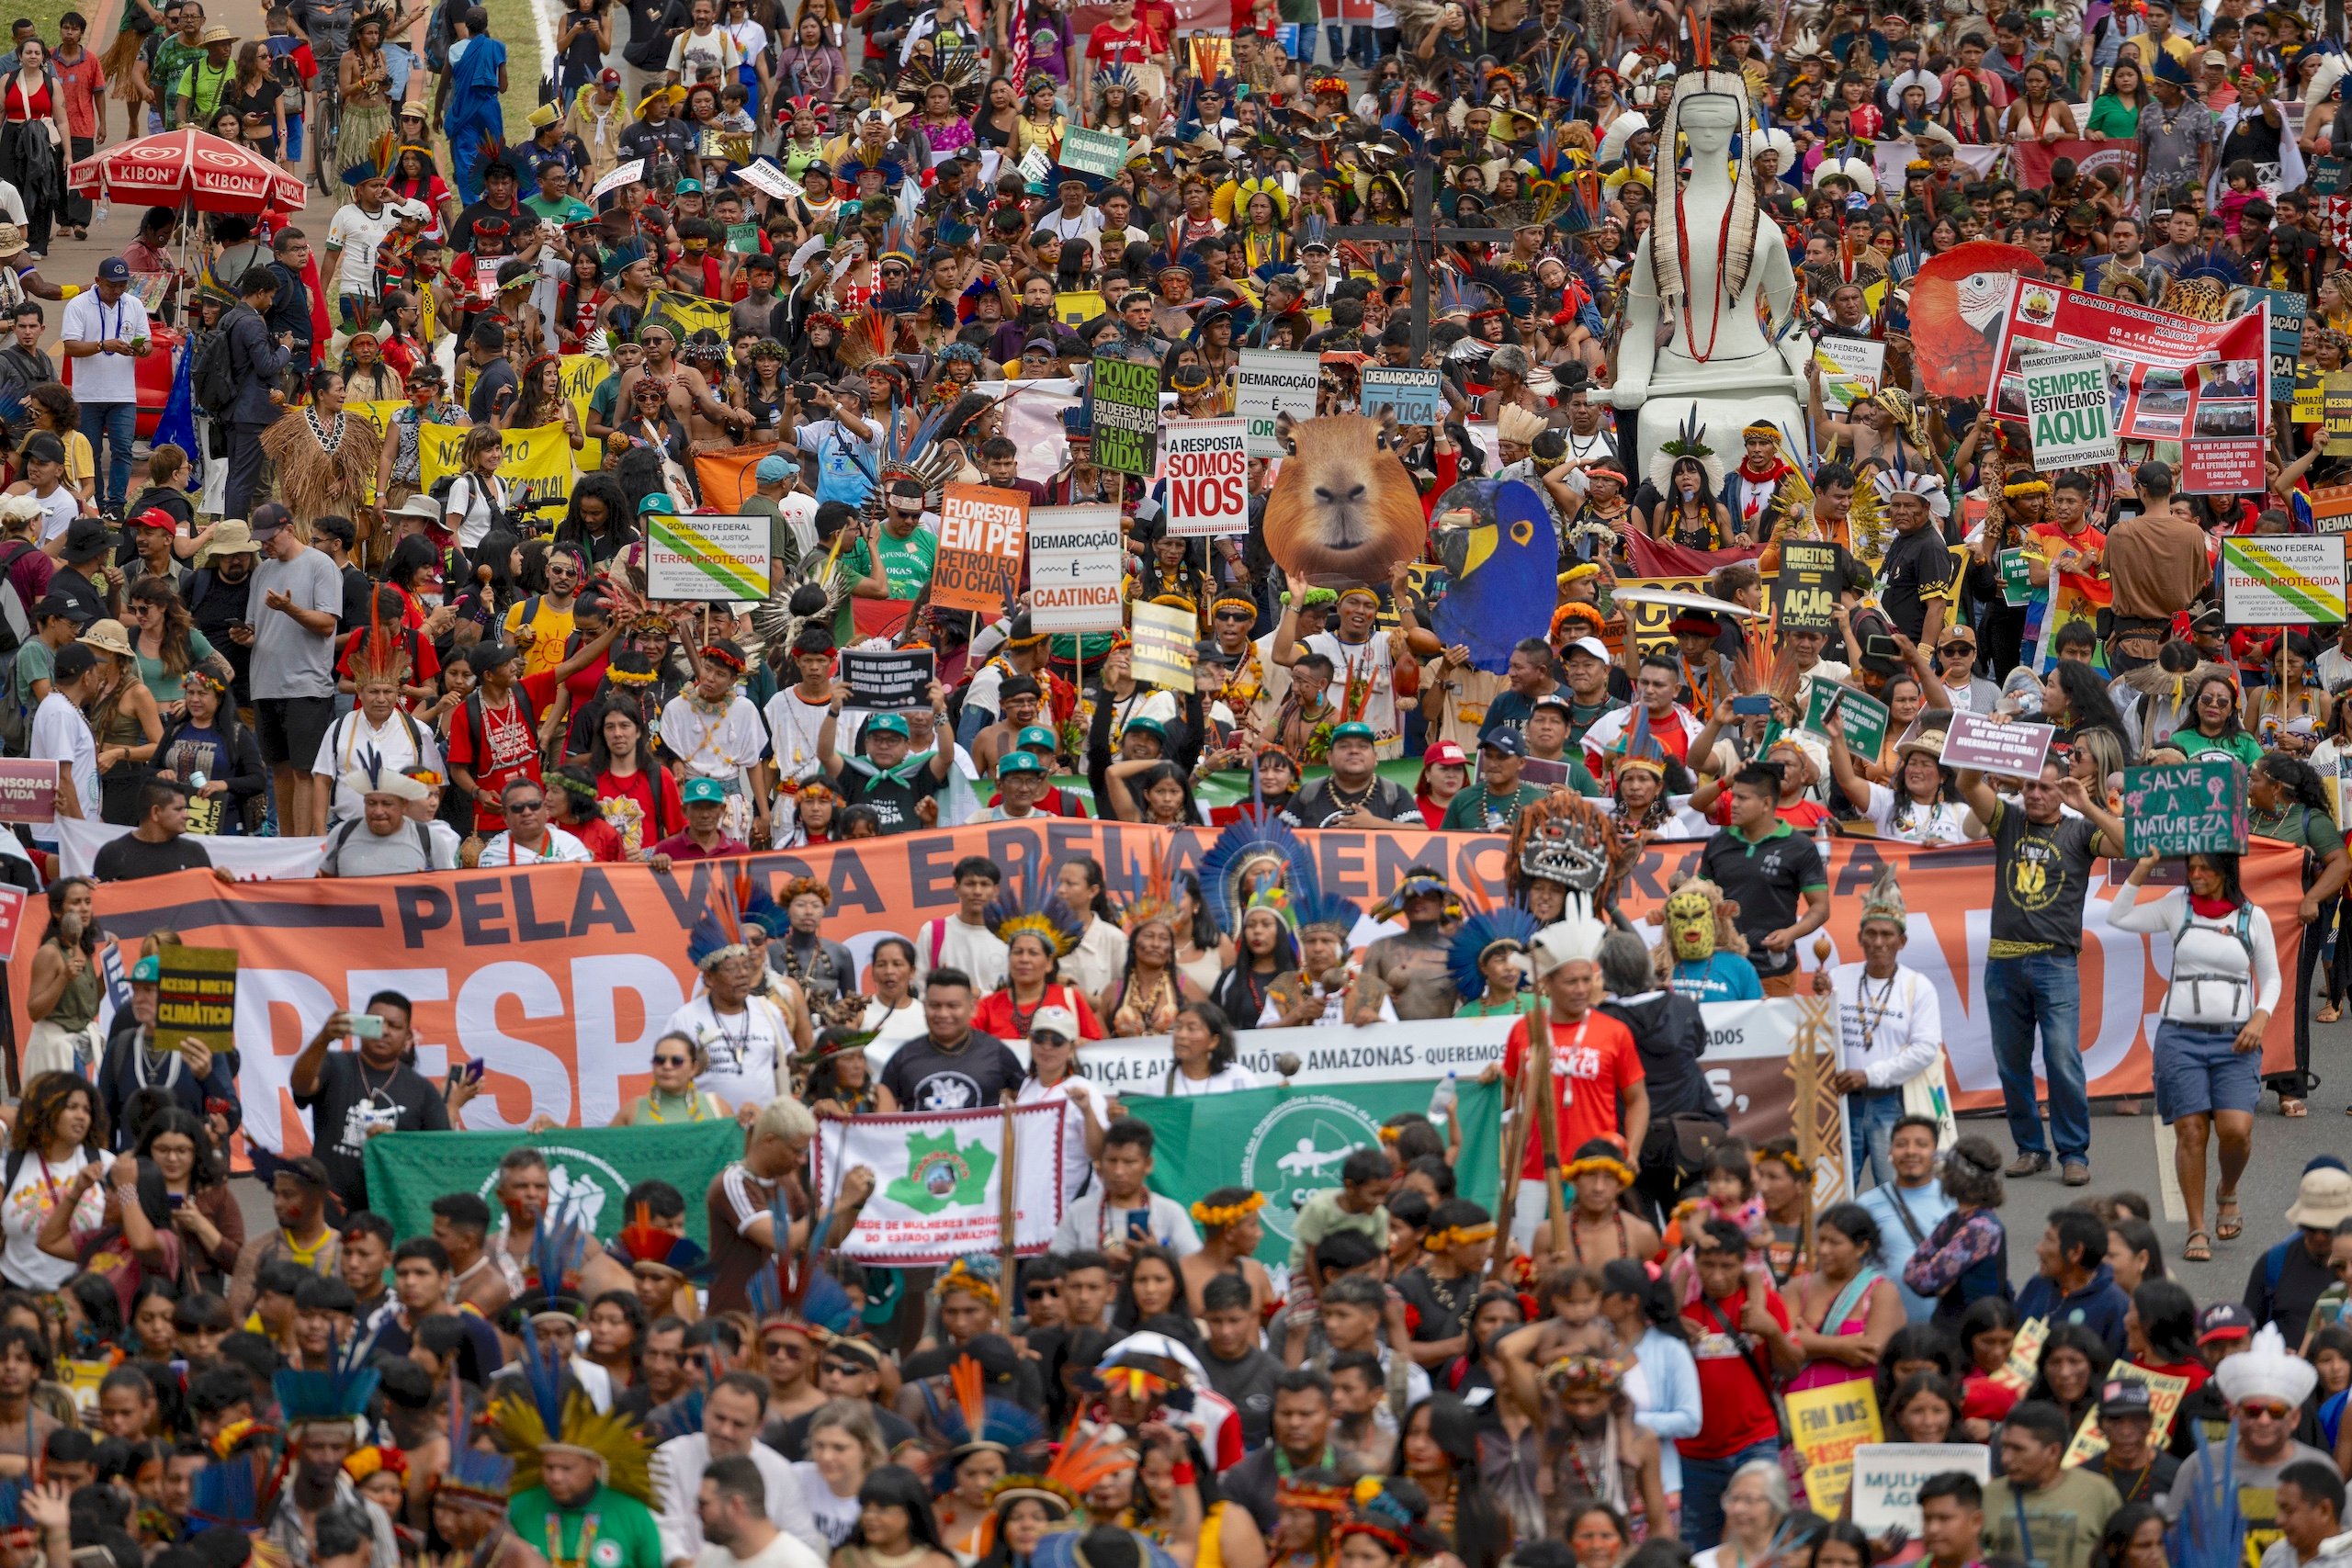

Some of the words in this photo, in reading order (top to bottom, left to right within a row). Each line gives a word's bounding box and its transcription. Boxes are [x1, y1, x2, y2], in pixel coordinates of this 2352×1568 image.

[1073, 128, 1119, 147] DEFENDER
[1066, 147, 1071, 157] E
[1073, 149, 1119, 165] DEFENDER
[1069, 138, 1082, 149] OS
[1083, 140, 1119, 157] BIOMAS
[1075, 158, 1084, 167] A
[1084, 160, 1106, 175] VIDA
[279, 180, 300, 199] KIBON
[2069, 294, 2115, 312] GRANDE
[2116, 305, 2188, 331] ASSEMBLEIA
[2190, 323, 2205, 333] DO
[2109, 326, 2120, 336] 08
[2133, 333, 2144, 342] 14
[2148, 336, 2194, 352] Dezembro
[2154, 326, 2199, 343] KAIOWÁ
[2021, 350, 2101, 367] #MARCOTEMPORALNÃO
[1095, 359, 1159, 393] POVOS
[1240, 372, 1317, 391] DEMARCAÇÃO
[1365, 370, 1438, 389] DEMARCAÇÃO
[2027, 369, 2104, 399] SEMPRE
[1396, 386, 1403, 399] É
[2030, 390, 2106, 413] ESTIVEMOS
[1093, 400, 1108, 413] EM
[1109, 401, 1141, 419] DEFESA
[1143, 407, 1156, 423] DA
[1272, 397, 1280, 411] É
[2305, 407, 2315, 415] DE
[1093, 410, 1156, 434] CONSTITUIÇÃO
[2036, 406, 2107, 447] AQUI
[1110, 428, 1118, 443] E
[1119, 428, 1136, 446] DA
[1170, 439, 1181, 453] A
[1182, 436, 1244, 452] RESPOSTA
[2232, 441, 2258, 450] NACIONAL
[1100, 440, 1145, 472] VIDA
[1169, 451, 1246, 478] SOMOS
[2036, 447, 2115, 467] #MARCOTEMPORALNÃO
[2191, 462, 2205, 470] PELA
[2207, 460, 2238, 470] EFETIVAÇÃO
[2247, 460, 2256, 468] LEI
[2205, 451, 2234, 461] EDUCAÇÃO
[2206, 470, 2242, 479] 11.645/2008
[1172, 470, 1244, 518] NÓS
[945, 498, 1022, 526] FLORESTA
[667, 523, 710, 531] GOVERNO
[940, 516, 983, 551] EM
[987, 521, 1022, 557] PÉ
[1032, 529, 1118, 549] DEMARCAÇÃO
[738, 543, 764, 551] Indígenas
[1786, 546, 1835, 564] DIREITOS
[2240, 544, 2284, 553] GOVERNO
[652, 553, 693, 564] TERRA
[696, 554, 764, 564] PROTEGIDA
[1071, 558, 1080, 577] É
[1786, 562, 1834, 571] TERRITORIAIS
[2242, 553, 2282, 562] MINISTÉRIO
[2295, 555, 2324, 564] JUSTIÇA
[2312, 564, 2339, 573] Indígenas
[934, 567, 962, 590] NO
[2228, 577, 2267, 588] TERRA
[2271, 575, 2341, 587] PROTEGIDA
[1033, 586, 1119, 607] CAATINGA
[1783, 586, 1833, 618] AÇÃO
[1782, 615, 1832, 626] CLIMÁTICA
[877, 660, 911, 671] CONSELHO
[851, 671, 882, 682] NACIONAL
[884, 673, 893, 682] DE
[893, 669, 928, 682] EDUCAÇÃO
[851, 682, 880, 693] ESCOLAR
[880, 682, 913, 694] INDÍGENA!
[1971, 728, 1986, 738] QUE
[1986, 731, 2019, 743] RESPEITE
[2019, 736, 2027, 744] A
[1956, 737, 2001, 750] DIVERSIDADE
[2001, 742, 2038, 757] CULTURAL!
[2139, 768, 2202, 794] SALVE
[6, 789, 36, 801] VIDA
[2166, 794, 2179, 812] A
[2133, 814, 2228, 838] NATUREZA
[2133, 833, 2229, 854] URGENTE
[394, 867, 635, 949] PELA
[907, 834, 961, 908] E
[158, 1000, 233, 1025] CLIMÁTICO
[1306, 1044, 1415, 1071] AMAZONAS
[1425, 1043, 1507, 1064] QUEREMOS
[885, 1220, 899, 1230] DE
[903, 1219, 963, 1229] MULHERES
[888, 1233, 931, 1243] ESTADO
